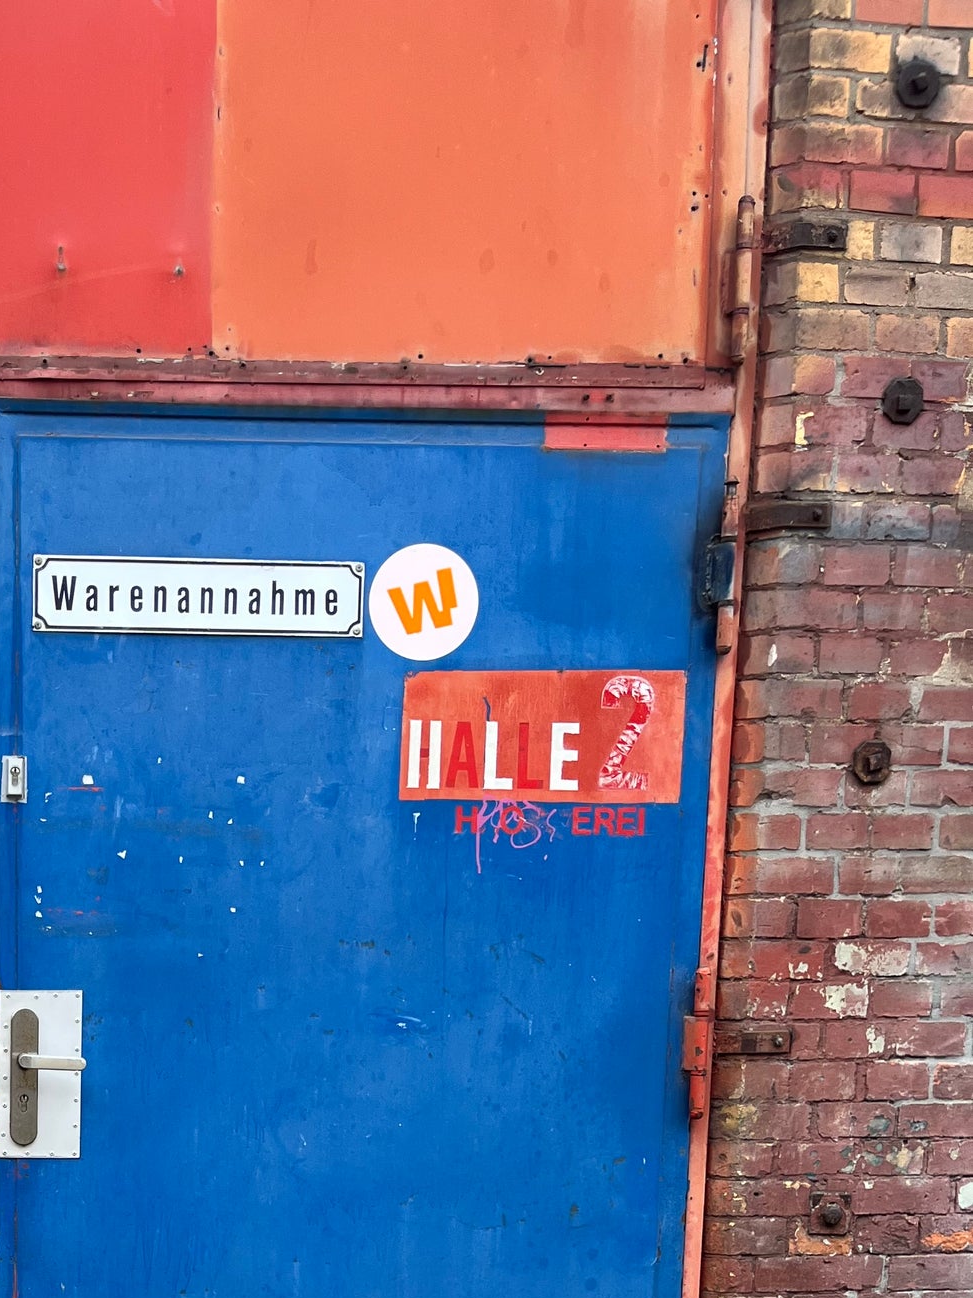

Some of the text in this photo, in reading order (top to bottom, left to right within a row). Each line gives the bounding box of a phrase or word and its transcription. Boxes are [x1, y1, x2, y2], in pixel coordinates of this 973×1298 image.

[51, 575, 338, 616] Warenannahme
[386, 567, 458, 635] W
[406, 675, 655, 791] HALLE 2
